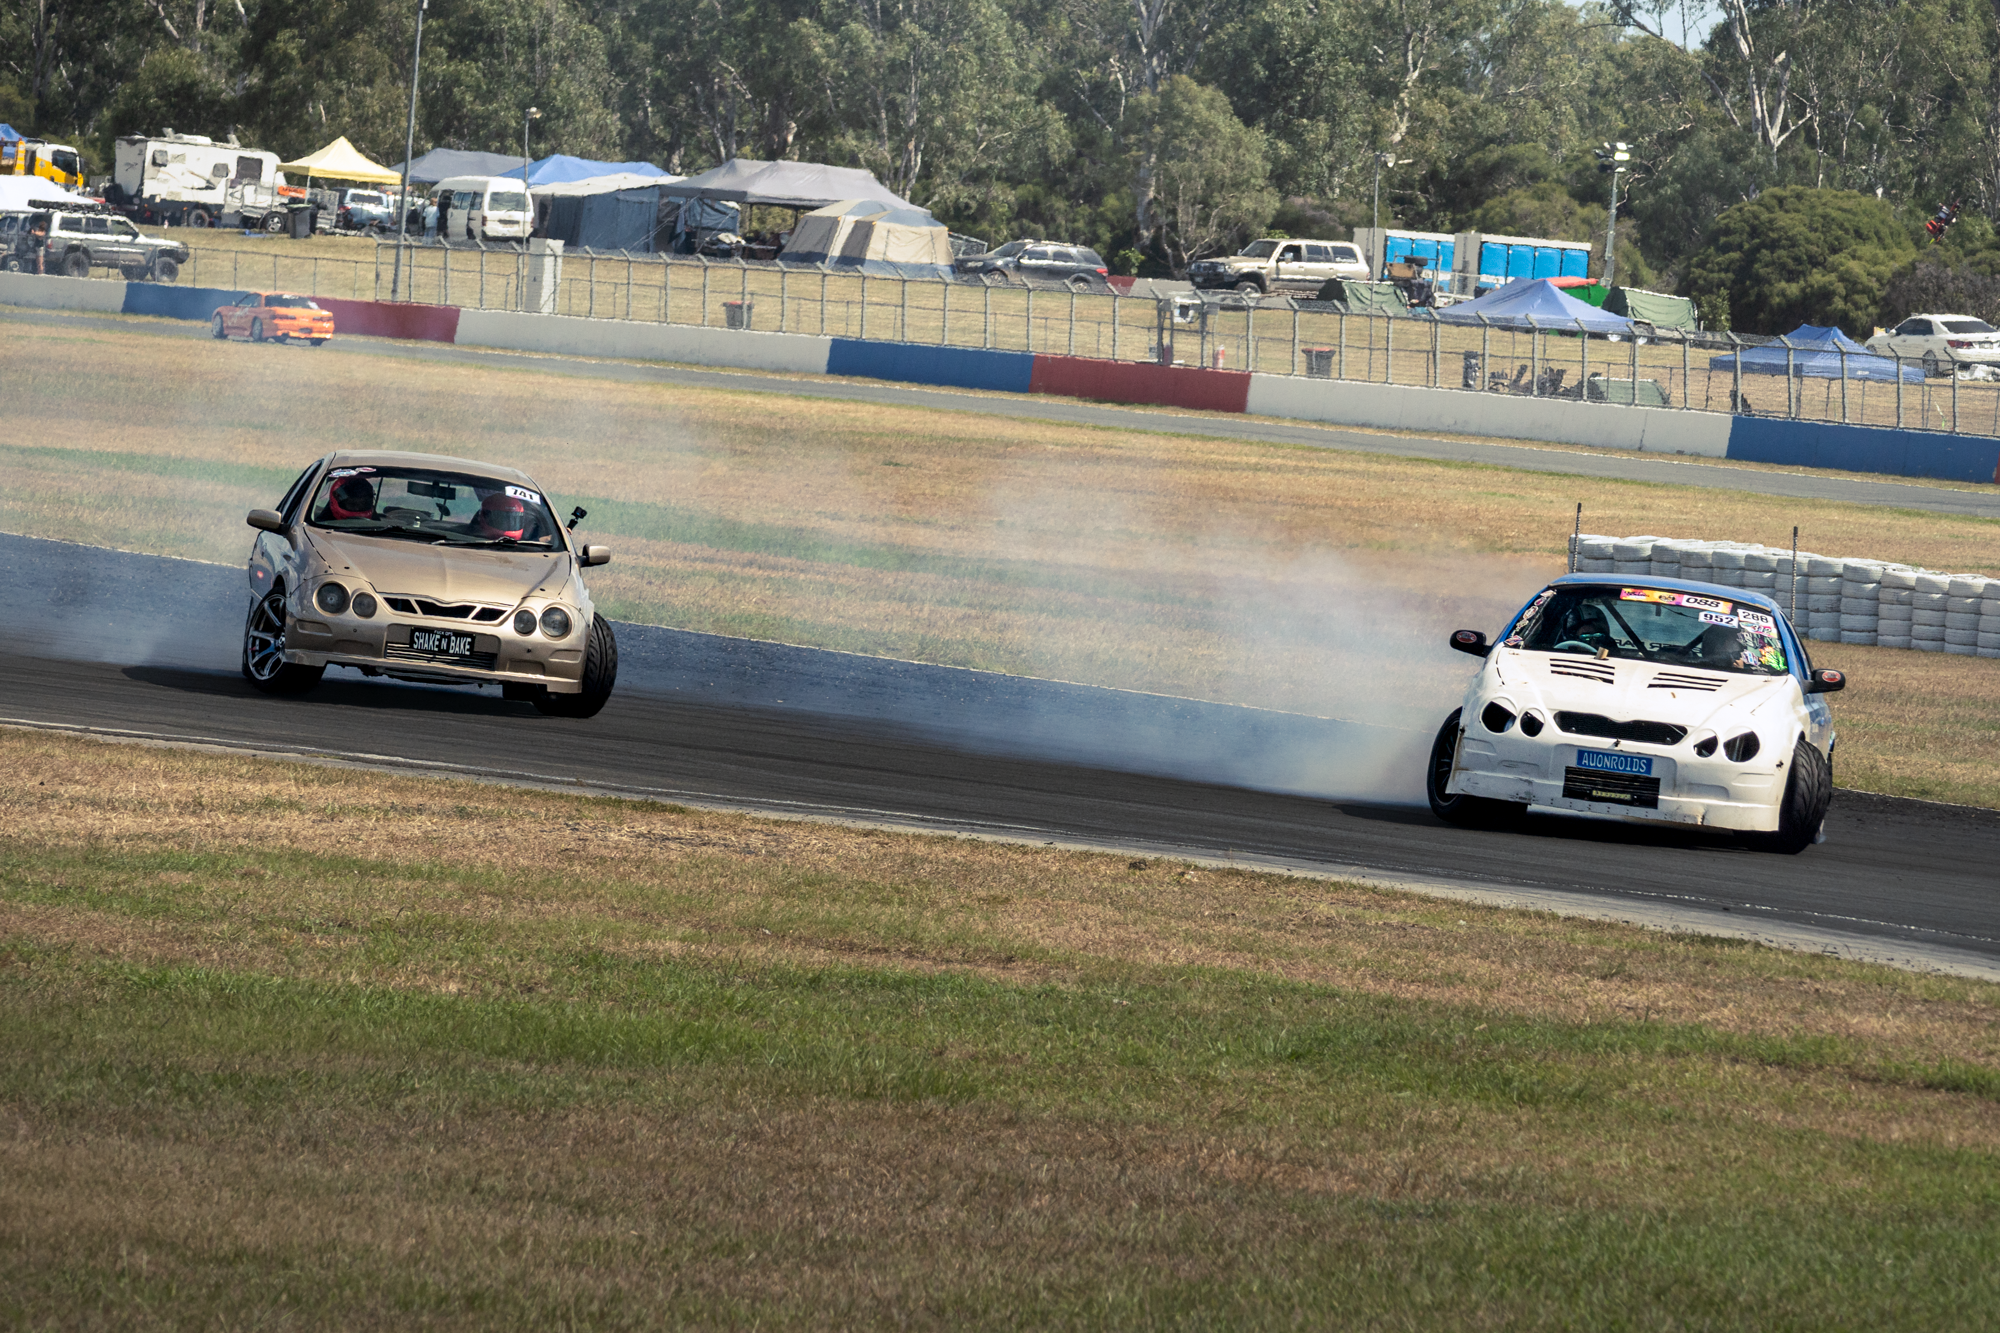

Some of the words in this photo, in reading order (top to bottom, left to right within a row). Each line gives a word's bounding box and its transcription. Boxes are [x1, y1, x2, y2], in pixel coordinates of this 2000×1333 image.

[1685, 597, 1721, 609] 088
[1703, 613, 1734, 626] 952
[1742, 611, 1769, 624] 288
[413, 632, 441, 651] SHAKE
[441, 638, 448, 650] N
[449, 636, 472, 655] BAKE
[1582, 752, 1647, 773] AUONROIDS
